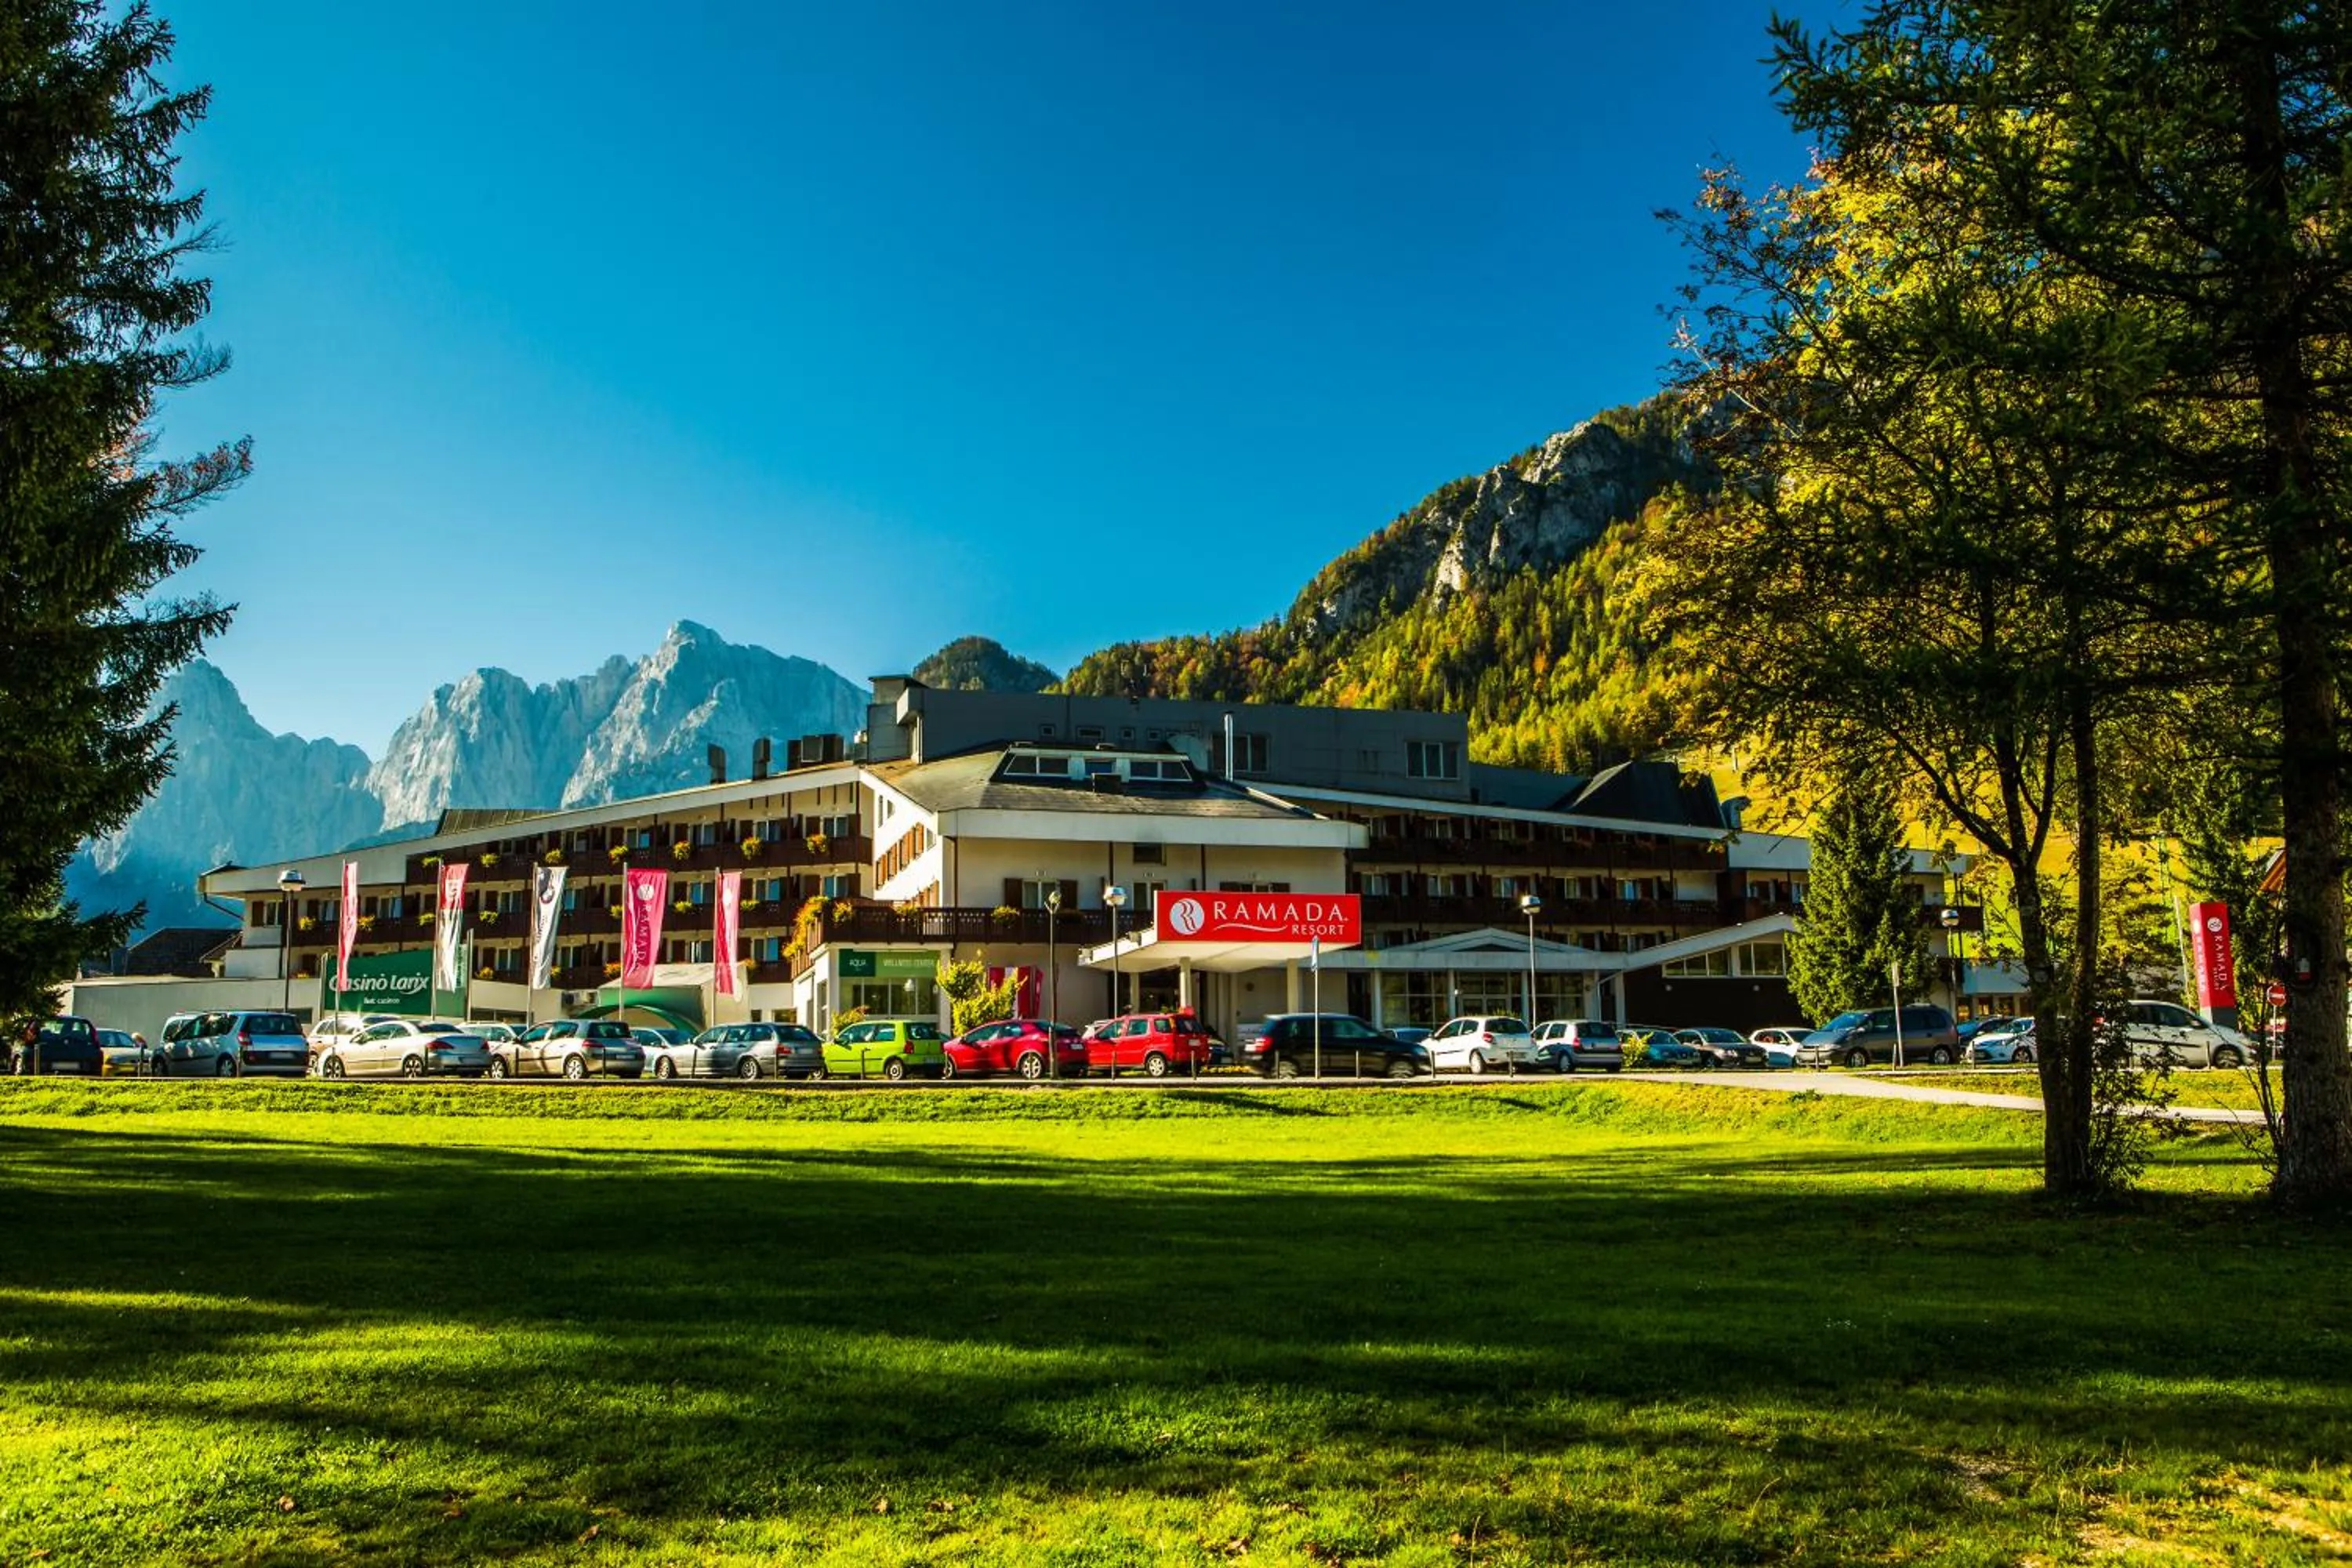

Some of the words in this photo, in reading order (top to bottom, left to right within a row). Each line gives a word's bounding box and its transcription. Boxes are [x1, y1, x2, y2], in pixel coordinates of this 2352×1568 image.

[1214, 901, 1344, 921] RAMADA
[1292, 924, 1345, 935] RESORT
[2214, 935, 2227, 991] RAMADA
[390, 972, 430, 995] Larix
